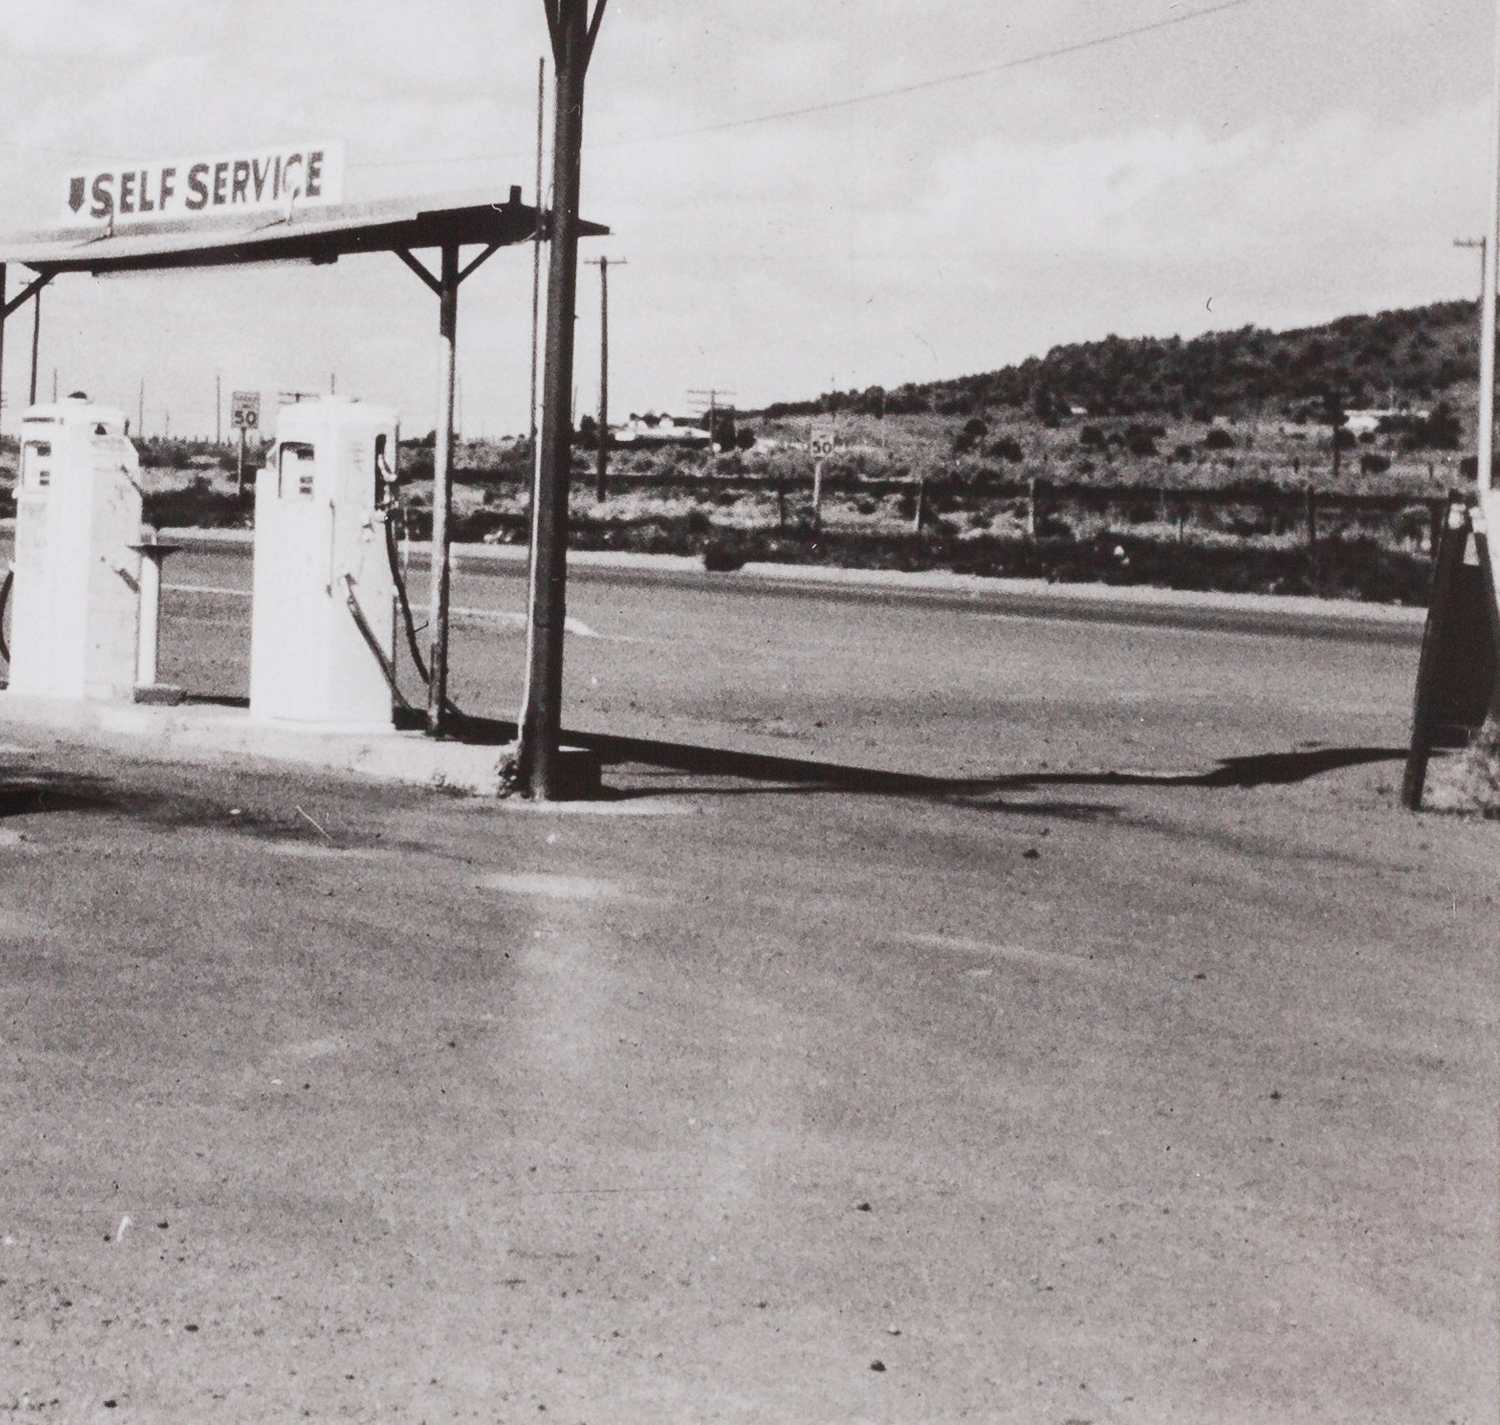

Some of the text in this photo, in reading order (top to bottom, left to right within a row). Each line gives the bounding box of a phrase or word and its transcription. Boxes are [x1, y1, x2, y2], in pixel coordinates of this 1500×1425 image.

[89, 150, 324, 219] SELF SERVICE
[234, 410, 257, 426] 50
[812, 440, 832, 454] 50
